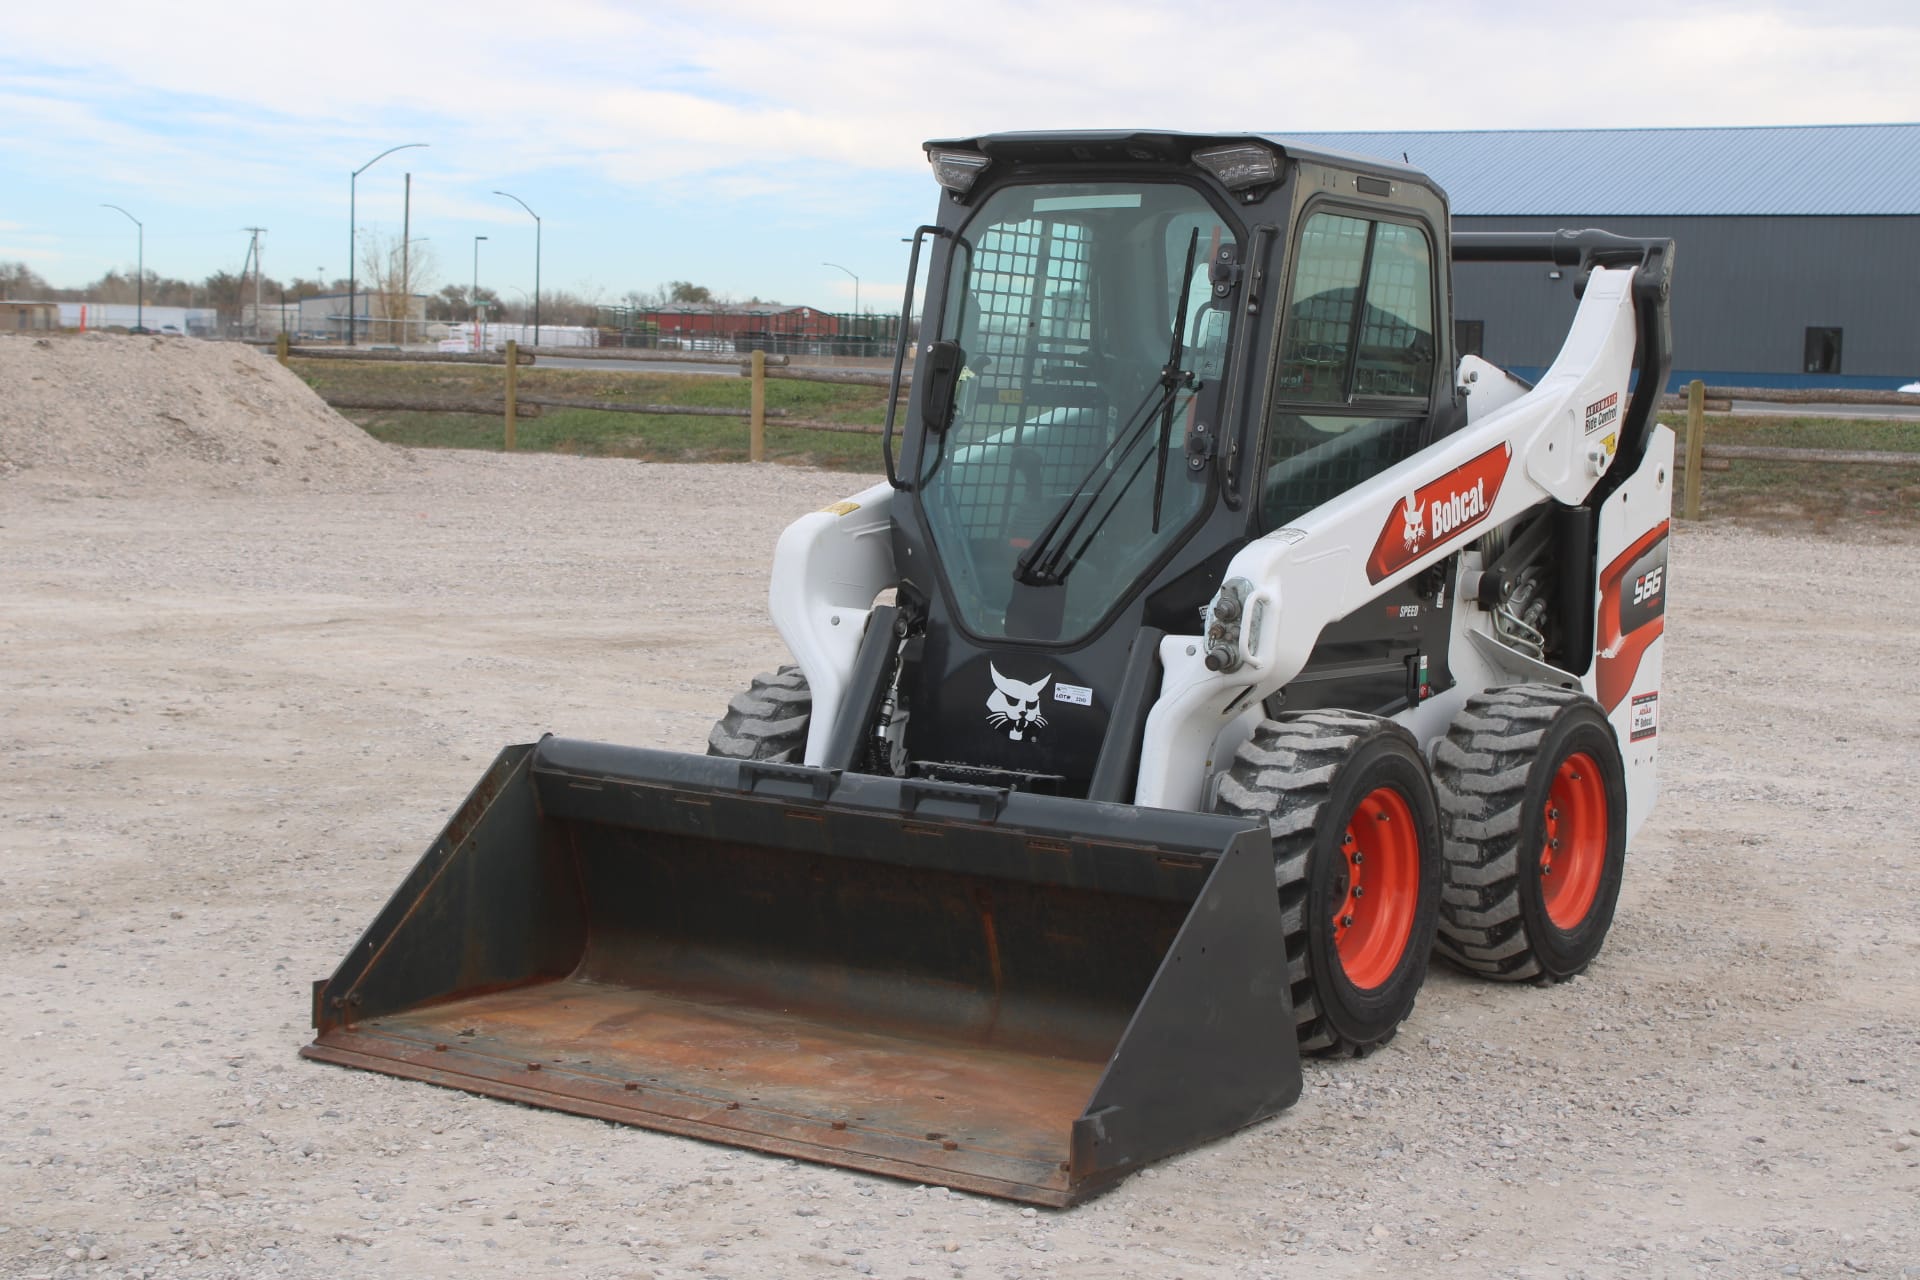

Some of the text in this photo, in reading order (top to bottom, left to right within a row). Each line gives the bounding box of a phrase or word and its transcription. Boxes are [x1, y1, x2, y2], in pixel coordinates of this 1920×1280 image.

[1585, 405, 1617, 432] Ride Control
[1586, 393, 1617, 418] AUTOMATIC
[1431, 477, 1485, 540] Bobcat
[1633, 566, 1663, 606] S66
[1400, 605, 1419, 618] SPEED
